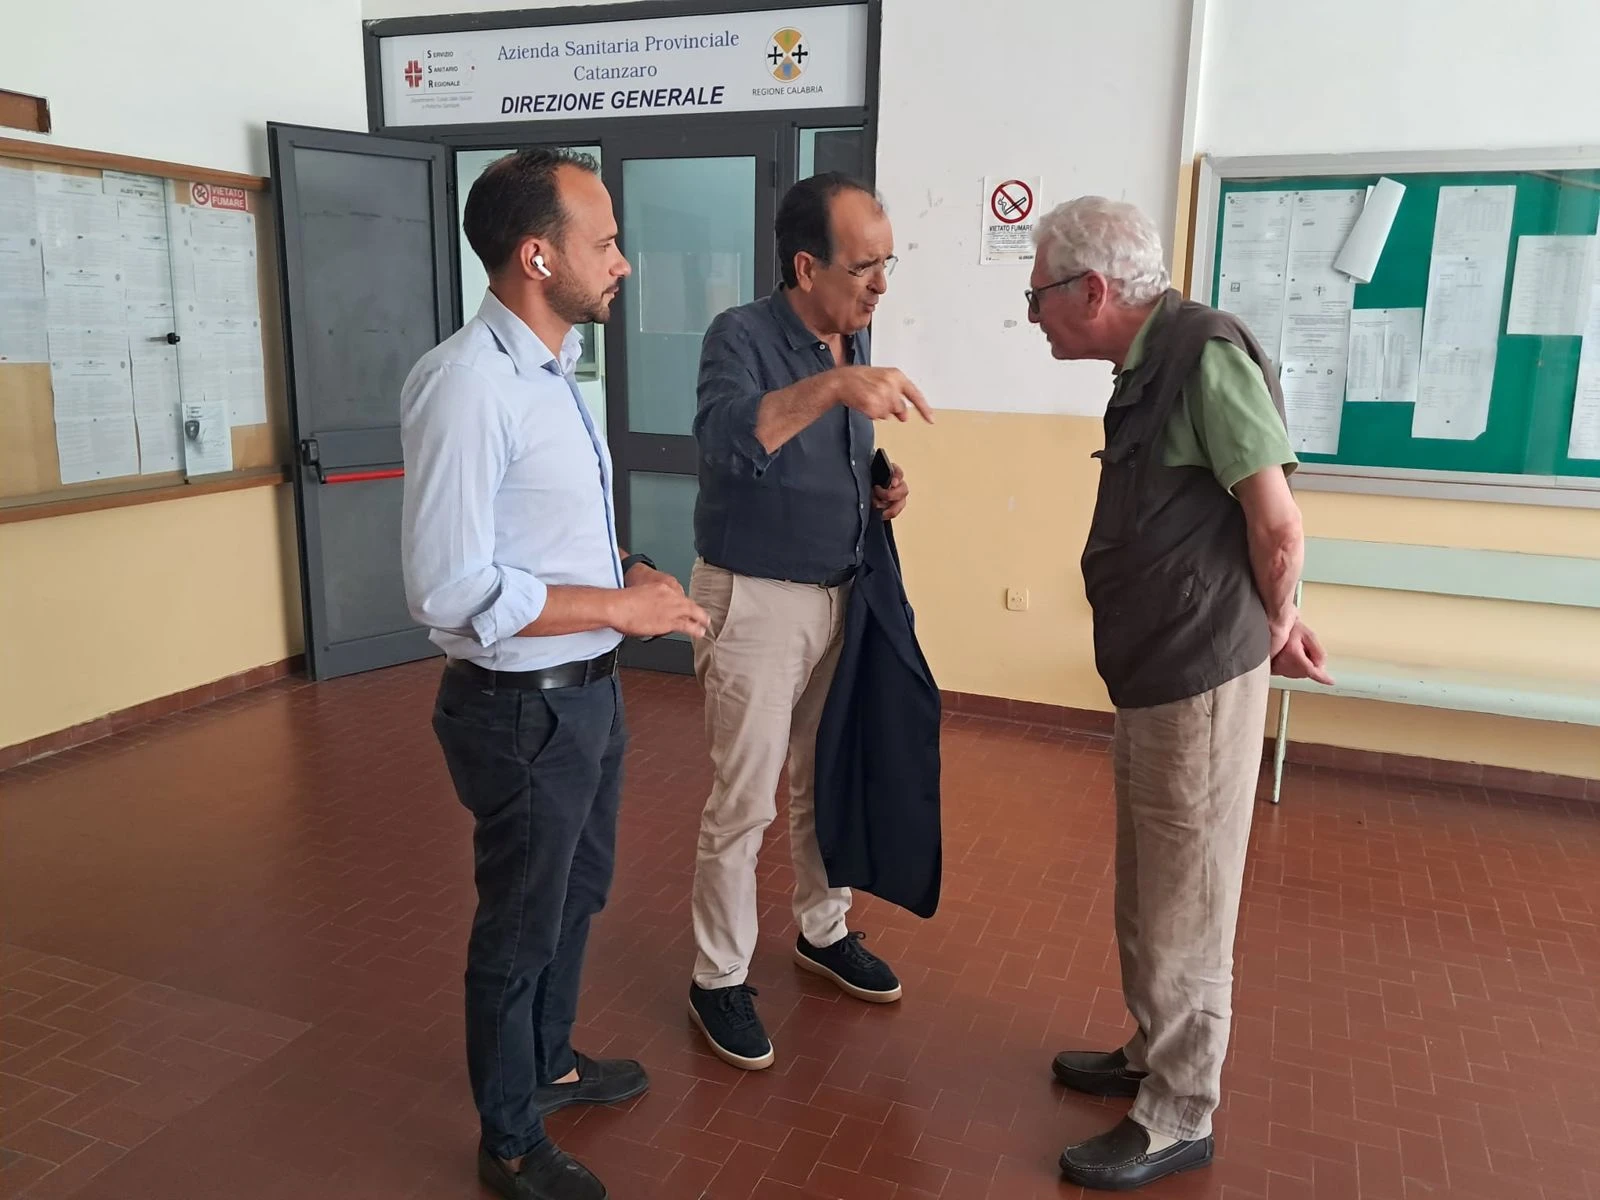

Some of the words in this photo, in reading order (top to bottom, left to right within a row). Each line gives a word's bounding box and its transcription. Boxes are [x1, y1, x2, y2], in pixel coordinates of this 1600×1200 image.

[498, 42, 560, 61] Azienda
[565, 38, 639, 57] Sanitaria
[645, 30, 740, 52] Provinciale
[574, 64, 658, 81] Catanzaro
[752, 87, 785, 96] REGIONE
[786, 85, 823, 95] CALABRIA
[501, 92, 606, 114] DIREZIONE
[610, 86, 725, 109] GENERALE
[212, 187, 244, 198] VIETATO
[212, 196, 245, 208] FUMARE
